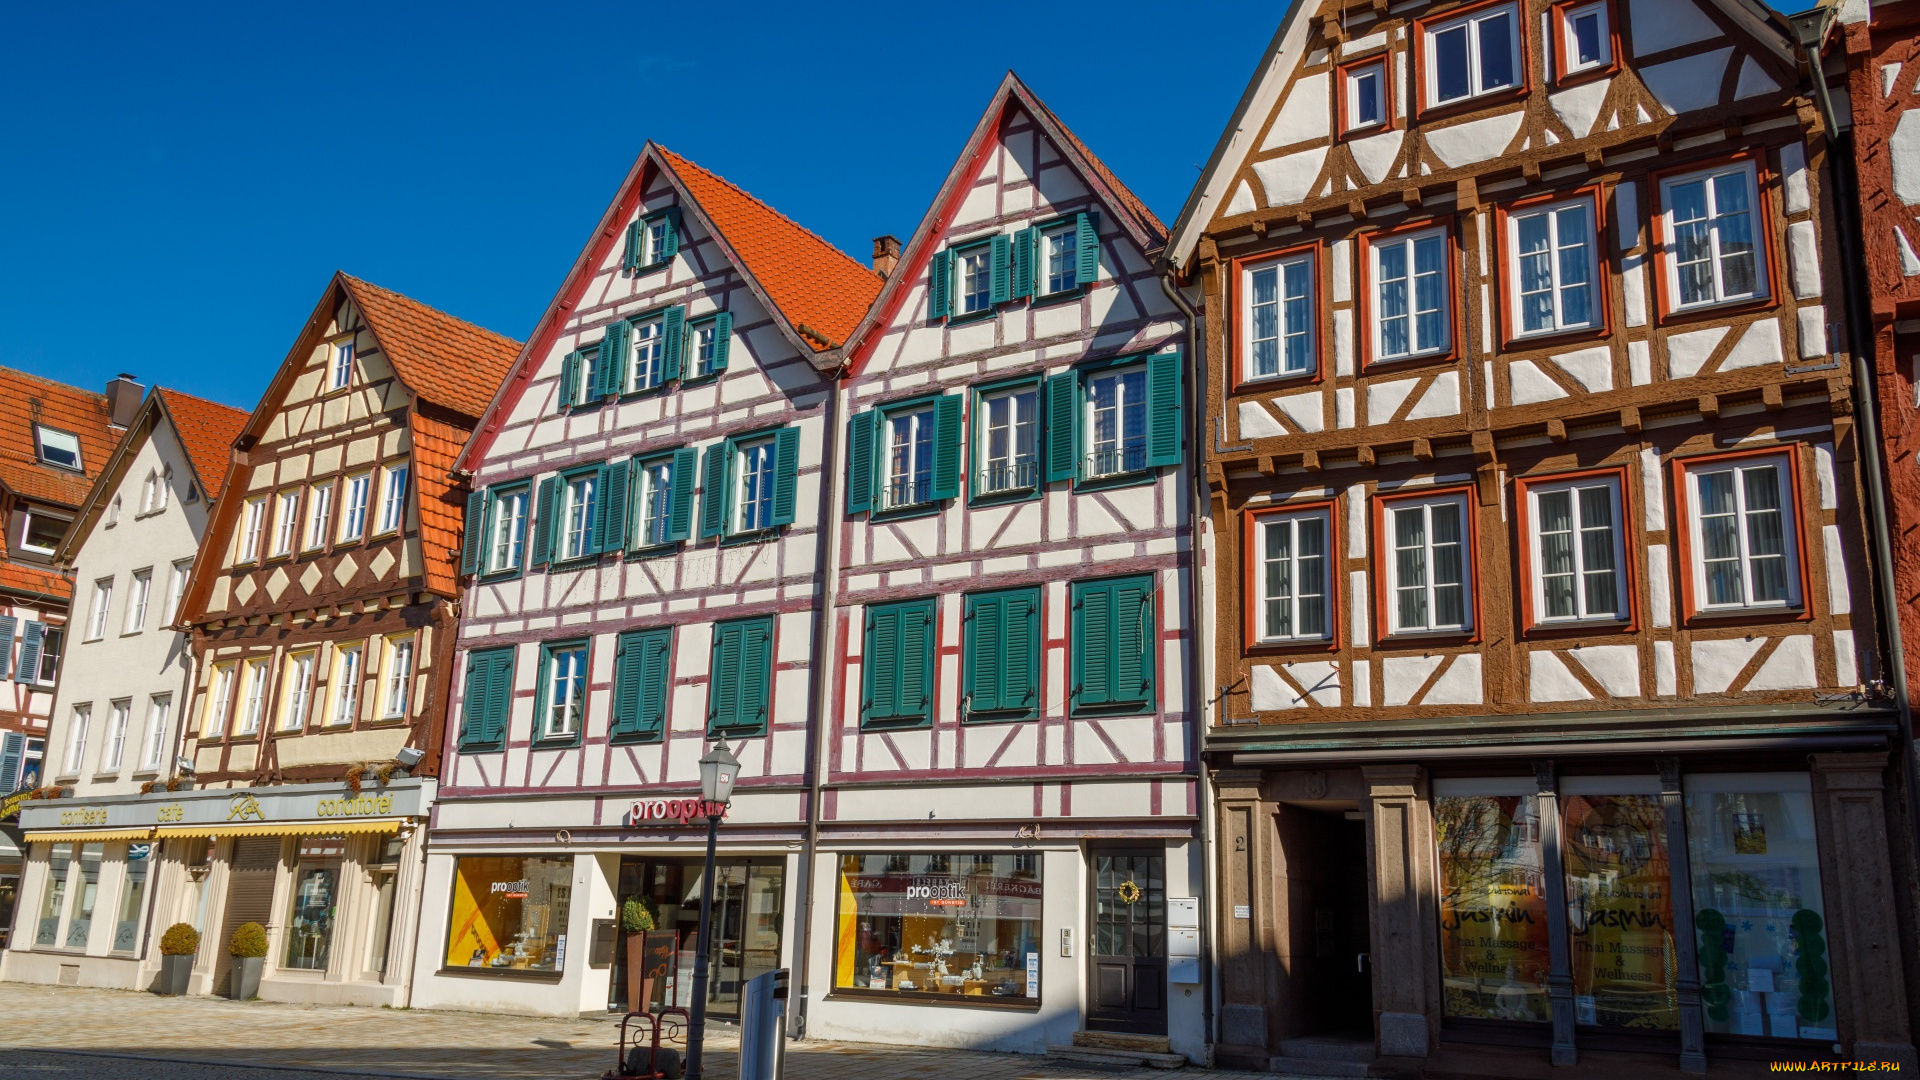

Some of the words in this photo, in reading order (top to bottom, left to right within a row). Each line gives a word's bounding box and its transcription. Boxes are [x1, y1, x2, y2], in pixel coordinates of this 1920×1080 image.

[60, 805, 108, 826] confiserie
[317, 791, 395, 817] conditorei
[1235, 836, 1246, 853] 2
[490, 880, 530, 894] prooptik
[906, 882, 966, 900] prooptik
[1480, 937, 1536, 950] Massage
[1575, 941, 1604, 953] Thai
[1486, 950, 1496, 961] &
[1615, 955, 1626, 967] &
[1465, 962, 1521, 974] Wellnes
[1594, 967, 1652, 981] Wellness
